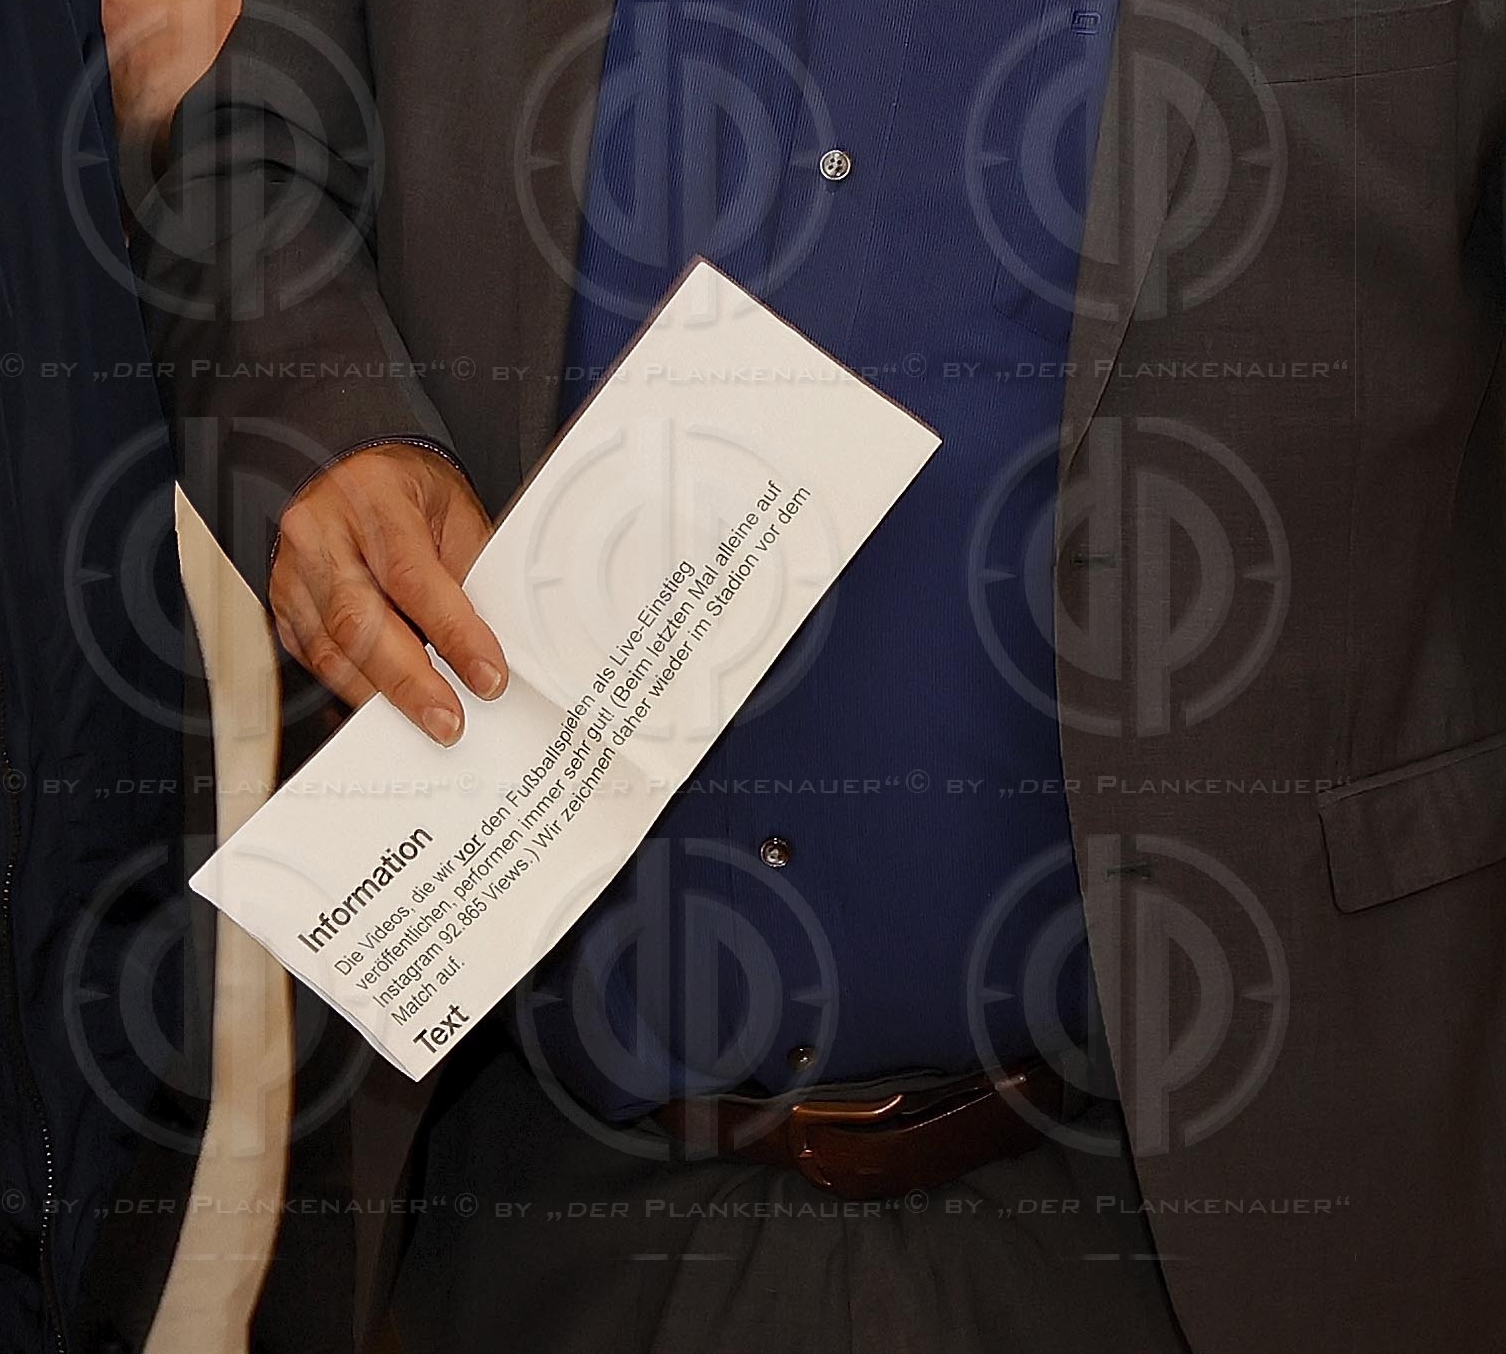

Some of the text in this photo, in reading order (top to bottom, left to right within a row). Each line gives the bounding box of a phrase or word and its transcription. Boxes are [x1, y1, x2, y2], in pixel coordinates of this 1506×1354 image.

[332, 950, 364, 976] Die
[356, 905, 416, 950] Videos,
[410, 881, 436, 904] die
[430, 858, 456, 883] wir
[452, 832, 487, 867] vor
[479, 805, 511, 836] den
[503, 694, 596, 808] Fußballspielen
[591, 666, 616, 694] als
[608, 559, 696, 667] Live-Einstieg
[354, 899, 458, 990] veröffentlichen,
[452, 828, 524, 902] performen
[516, 777, 566, 831] immer
[562, 737, 592, 780] sehr
[585, 705, 615, 743] gut!
[608, 657, 654, 709] (Beim
[644, 600, 695, 658] letzten
[686, 563, 719, 601] Mal
[714, 512, 759, 567] alleine
[755, 478, 782, 512] auf
[371, 941, 444, 1009] Instagram
[436, 895, 488, 945] 92.865
[479, 846, 541, 900] Views.)
[530, 818, 563, 848] Wir
[562, 740, 616, 823] zeichnen
[610, 696, 652, 746] daher
[646, 639, 693, 697] wieder
[686, 617, 712, 642] im
[704, 552, 760, 617] Stadion
[753, 522, 781, 551] vor
[776, 486, 811, 525] dem
[296, 827, 434, 954] Information
[389, 953, 466, 1027] Match auf.
[411, 1003, 471, 1054] Text
